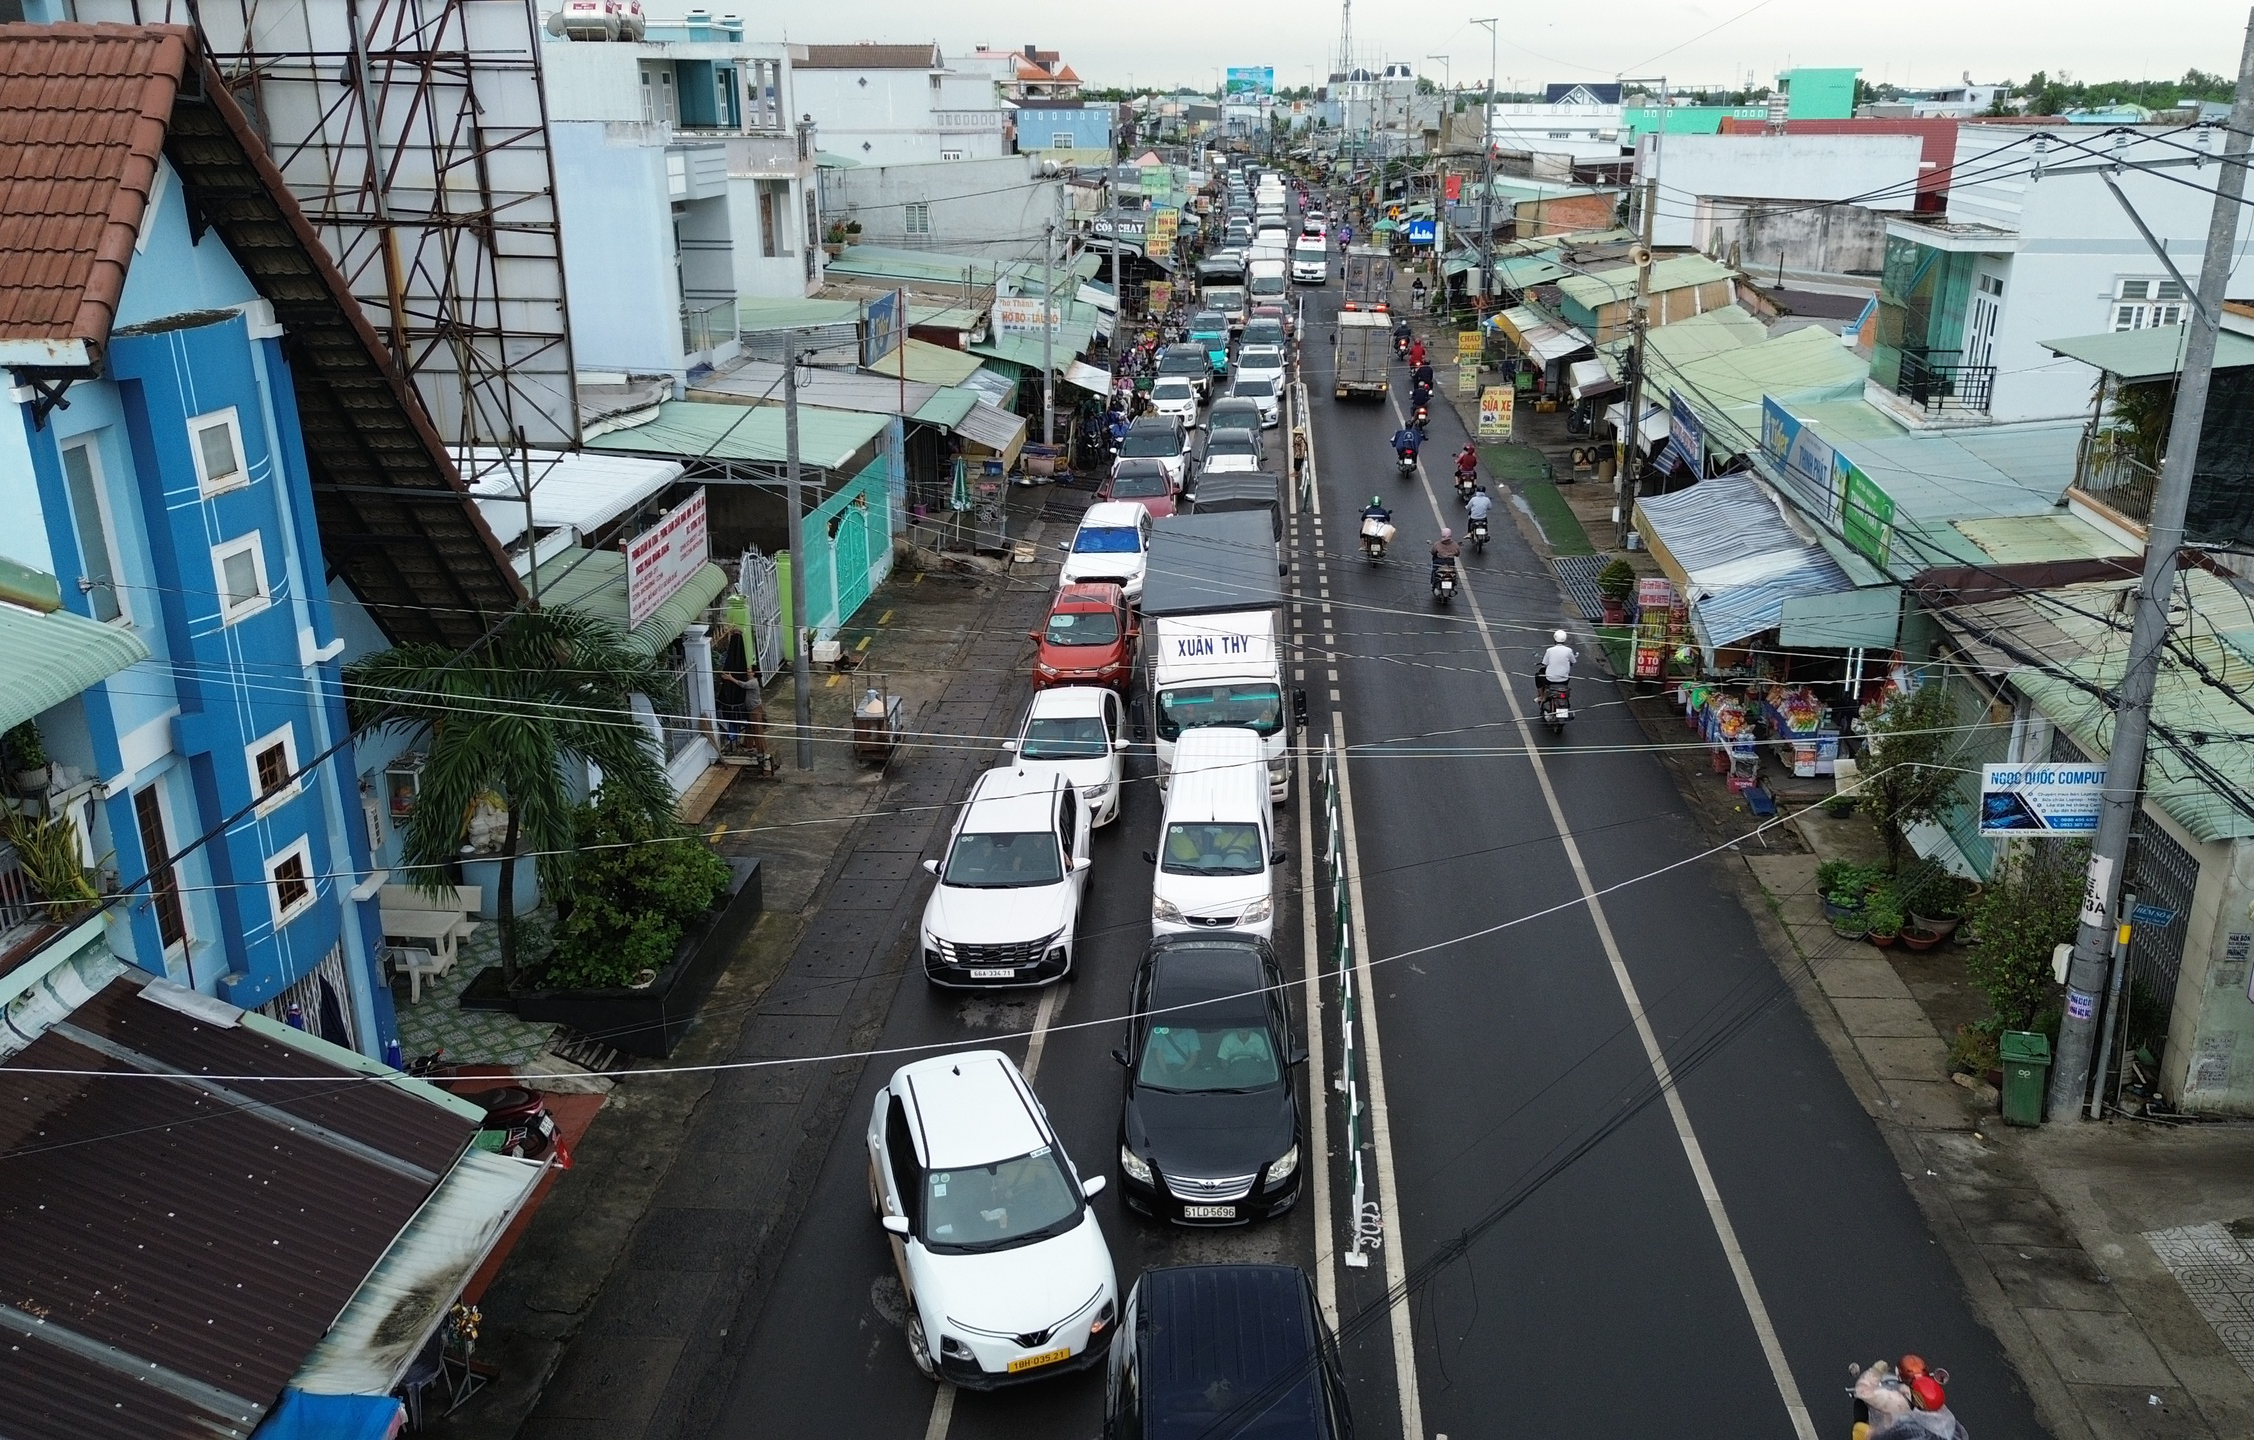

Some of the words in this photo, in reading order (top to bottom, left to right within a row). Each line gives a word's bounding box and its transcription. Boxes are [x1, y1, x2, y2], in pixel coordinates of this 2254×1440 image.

[1118, 223, 1144, 234] CHAY
[1482, 395, 1498, 411] SỬA
[1500, 400, 1512, 411] XE
[1178, 635, 1213, 657] XUÂN
[1221, 635, 1248, 654] THY
[1647, 656, 1659, 665] TÔ
[2025, 768, 2055, 785] QUỐC
[2058, 771, 2107, 785] COMPUT
[1185, 1206, 1235, 1217] 51LD-5696
